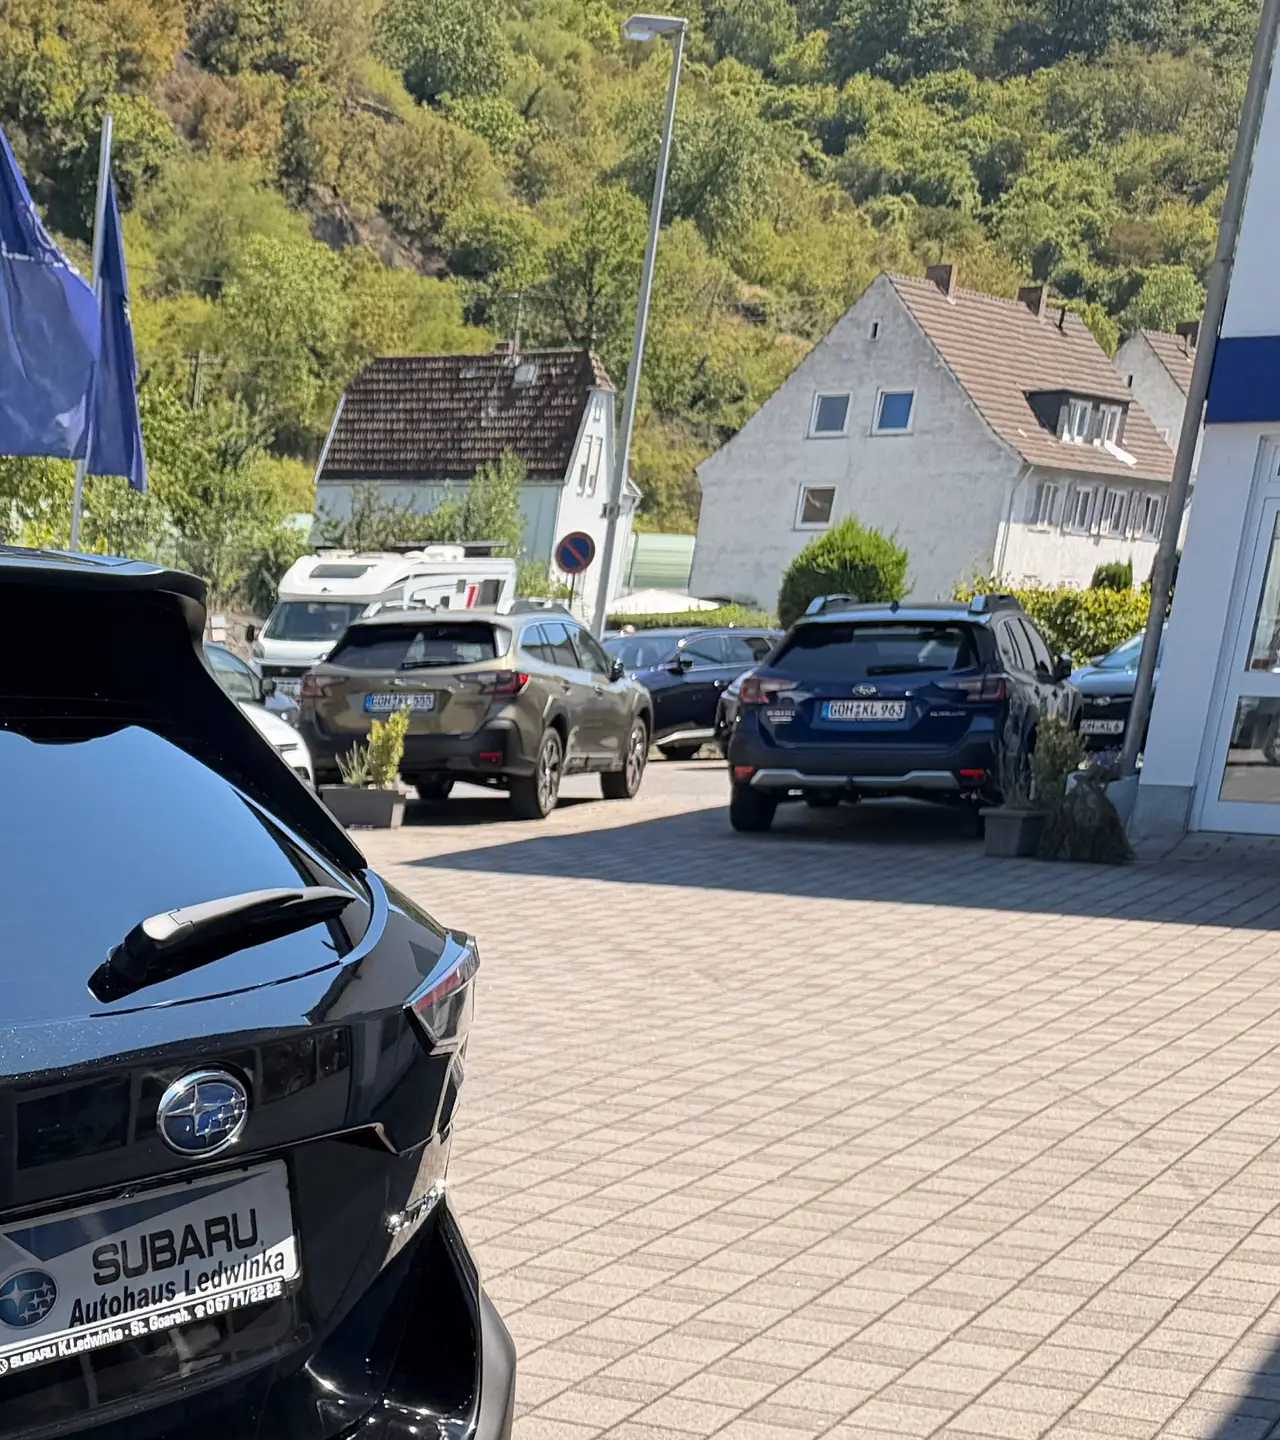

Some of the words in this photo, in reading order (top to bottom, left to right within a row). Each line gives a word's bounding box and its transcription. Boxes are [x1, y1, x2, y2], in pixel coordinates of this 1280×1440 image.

[862, 701, 877, 717] KL
[881, 701, 904, 717] 963
[92, 1207, 258, 1287] SUBARU
[68, 1279, 176, 1329] Autohaus
[184, 1246, 285, 1296] Ledwinka
[10, 1344, 57, 1369] SUBARU
